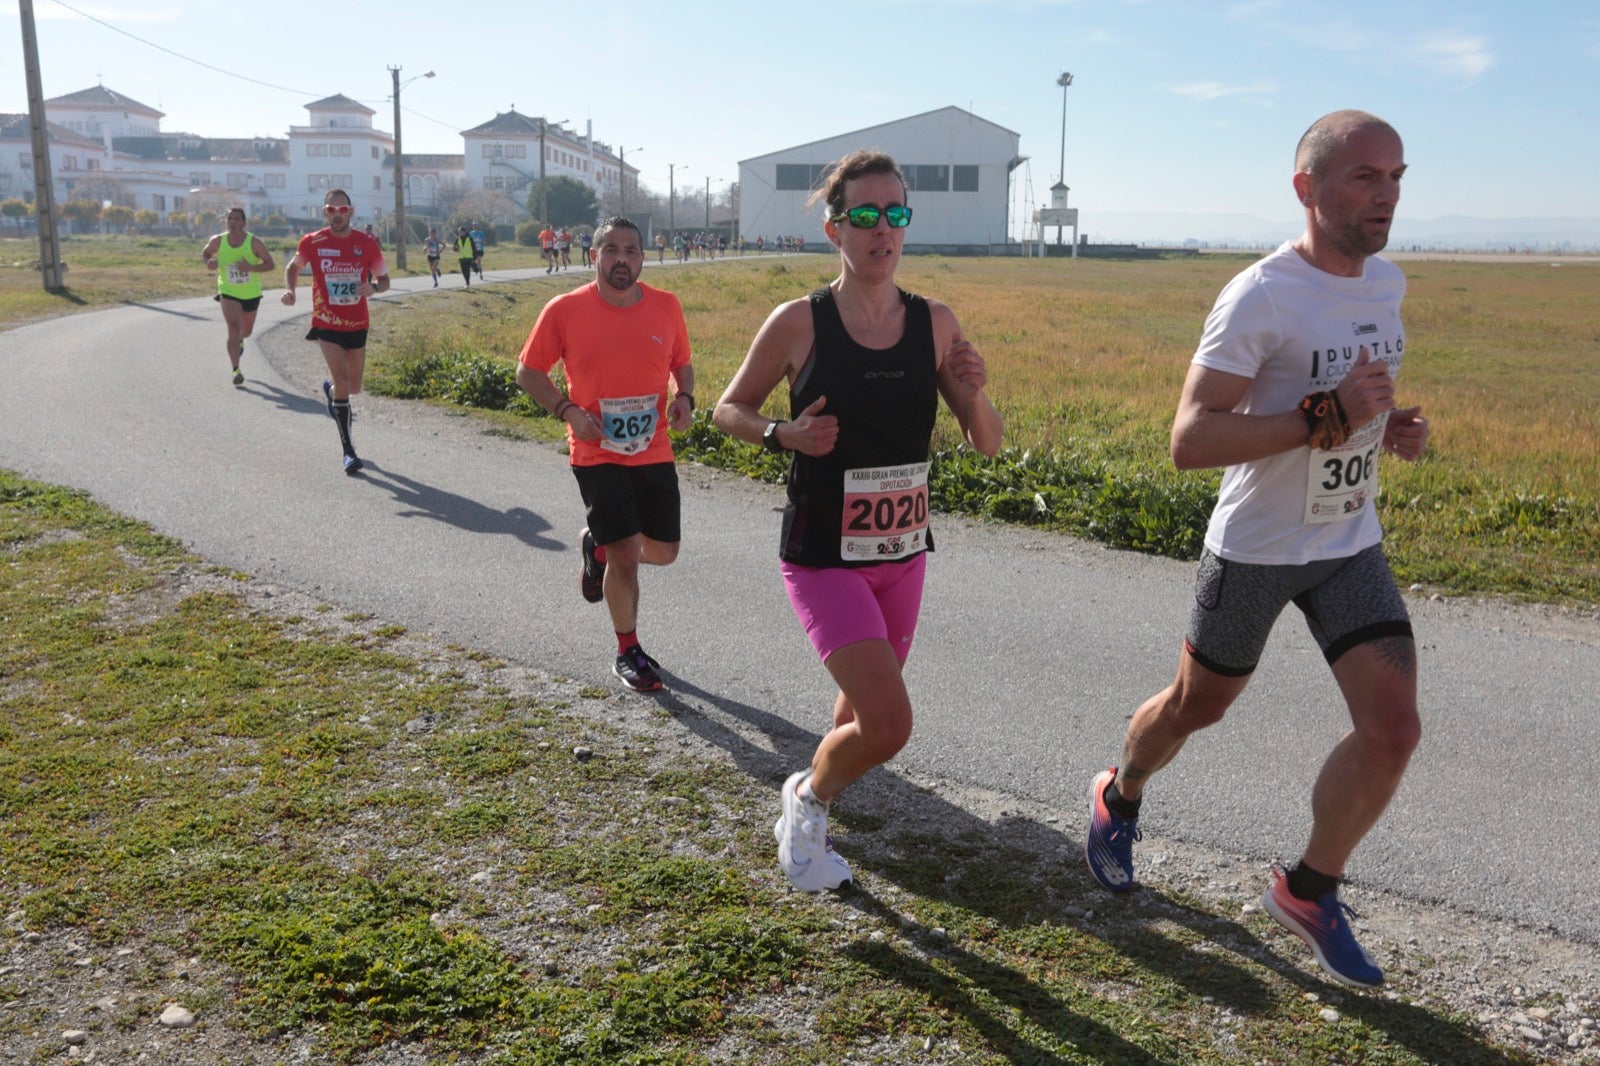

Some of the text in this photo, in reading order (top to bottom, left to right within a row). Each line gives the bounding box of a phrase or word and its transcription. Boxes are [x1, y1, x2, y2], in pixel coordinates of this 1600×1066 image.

[332, 283, 357, 295] 726
[1327, 334, 1403, 363] DUTLÓ
[612, 414, 652, 439] 262
[871, 470, 889, 480] GRAN
[889, 468, 910, 478] PREMIO
[848, 491, 926, 531] 2020
